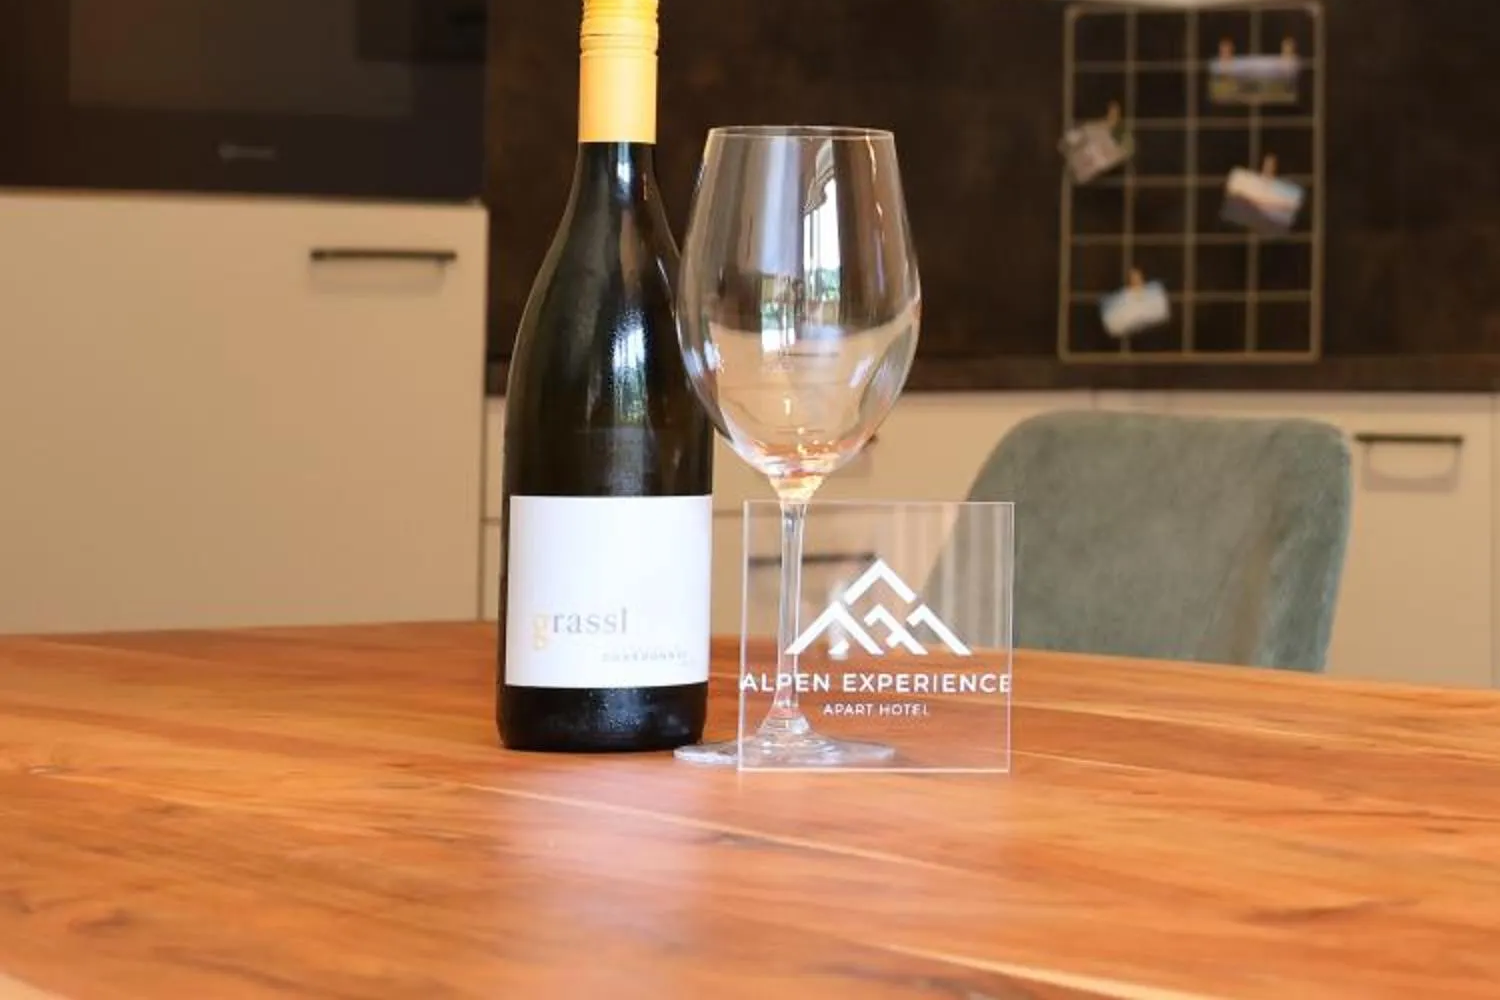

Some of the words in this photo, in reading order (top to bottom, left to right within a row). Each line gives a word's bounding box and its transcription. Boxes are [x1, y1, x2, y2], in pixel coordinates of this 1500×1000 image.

[532, 607, 628, 651] grassl
[740, 673, 831, 693] ALPEN
[843, 673, 1011, 694] EXPERIENCE
[823, 703, 873, 717] APART
[879, 703, 929, 717] HOTEL
